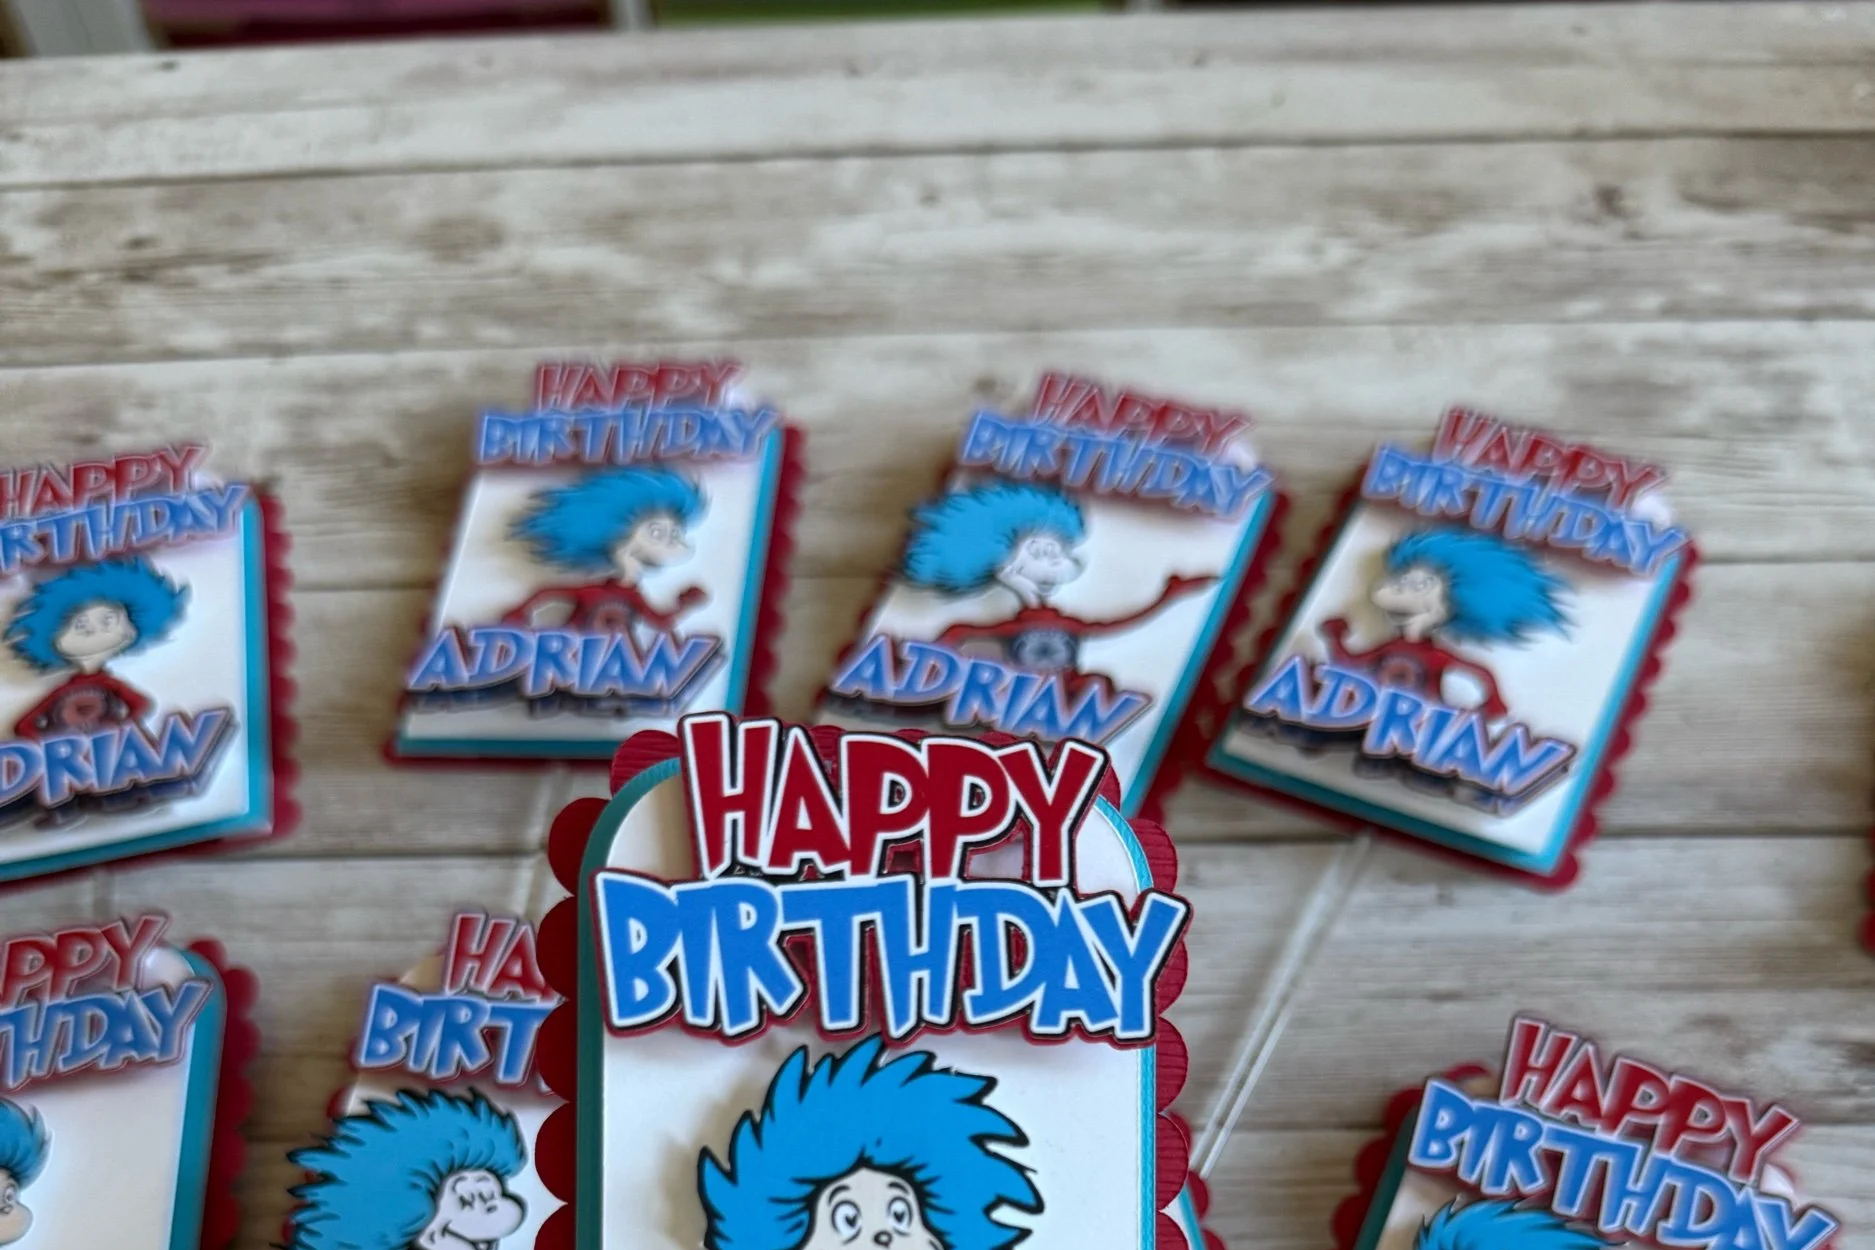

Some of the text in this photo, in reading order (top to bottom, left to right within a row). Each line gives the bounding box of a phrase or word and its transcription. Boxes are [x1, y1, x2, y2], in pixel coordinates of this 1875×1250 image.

[478, 404, 780, 465] BIRTHDAY
[536, 361, 746, 412] HAPPY
[1033, 372, 1254, 456] HAPPY
[0, 443, 208, 518] HAPPY
[960, 410, 1276, 521] BIRTHDAY
[1362, 443, 1692, 577] BIRTHDAY
[1432, 407, 1670, 512] HAPPY
[0, 482, 250, 572] RTHDAY
[404, 624, 730, 700] ADRIAN
[832, 632, 1155, 745] ADRIAN
[0, 706, 232, 806] DRIAN
[1244, 653, 1580, 800] ADRIAN
[680, 710, 1108, 890] HAPPY
[0, 912, 173, 1010] PPY
[592, 868, 1192, 1045] BIRTHDAY
[1500, 1015, 1799, 1184] HAPPY
